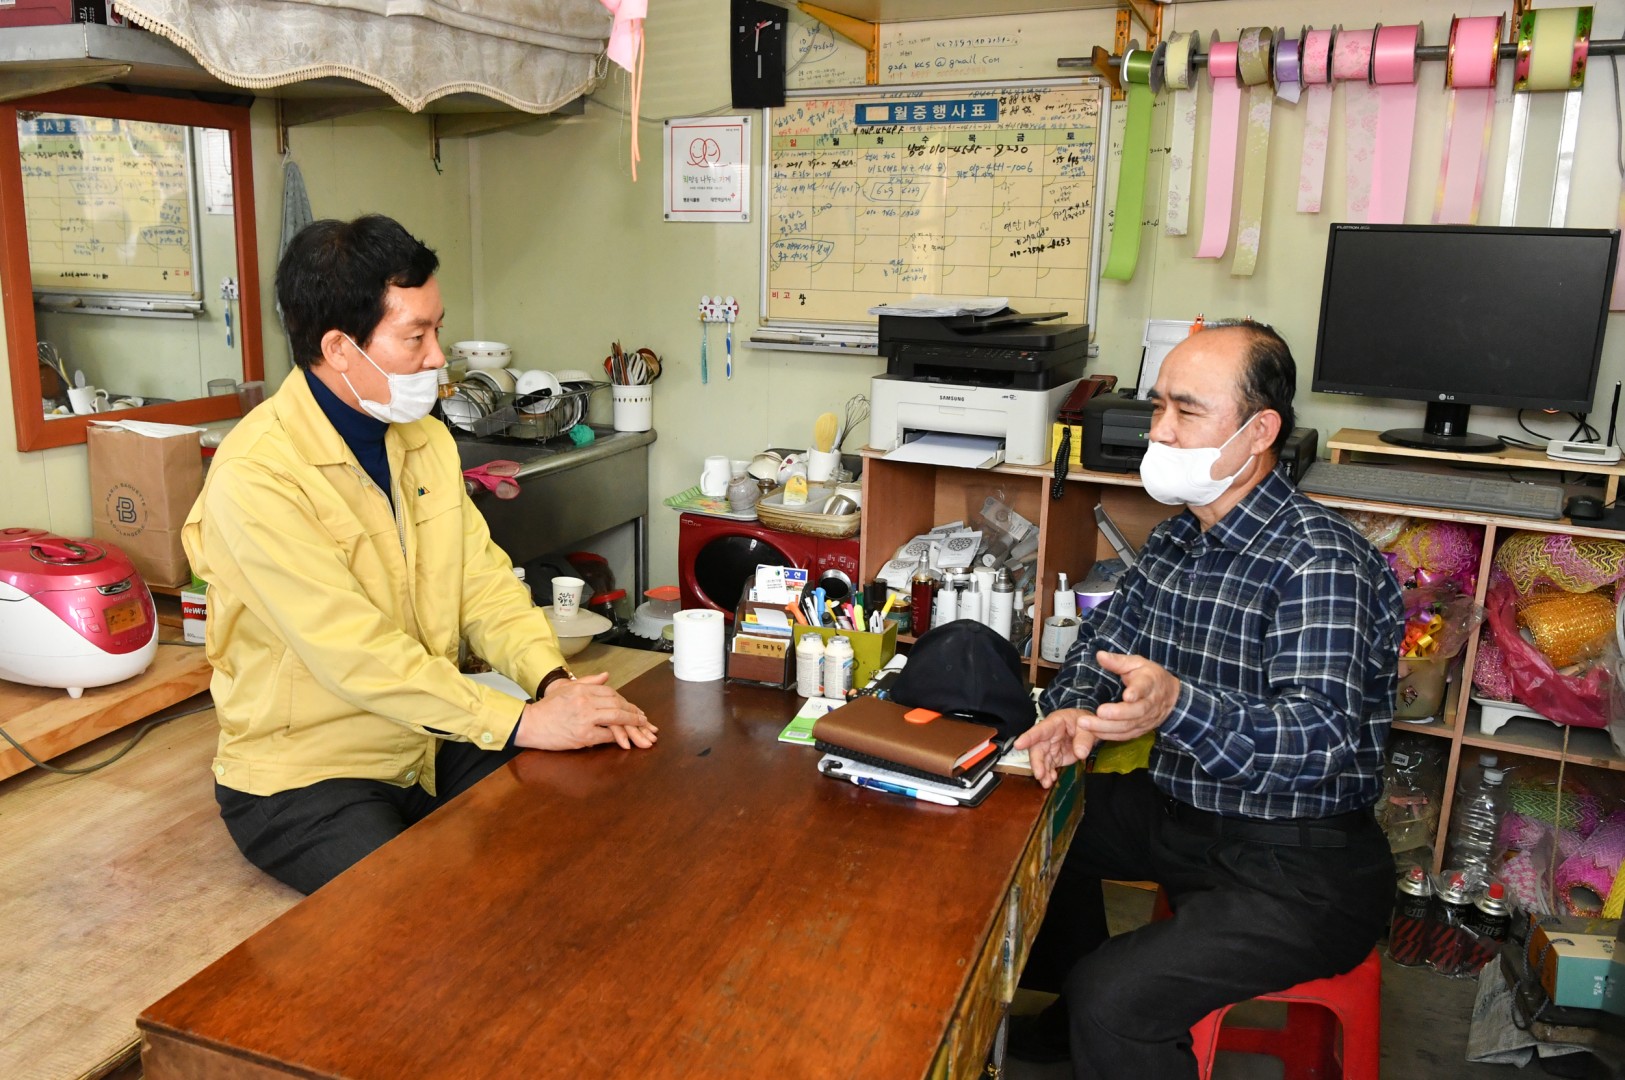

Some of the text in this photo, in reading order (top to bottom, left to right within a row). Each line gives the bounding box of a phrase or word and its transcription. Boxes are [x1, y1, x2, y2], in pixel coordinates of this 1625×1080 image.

[935, 57, 946, 67] @
[949, 54, 976, 68] gmail
[893, 103, 986, 121] 월중행사표
[877, 136, 884, 145] 화
[921, 135, 930, 143] 수
[968, 134, 976, 142] 목
[1017, 133, 1025, 142] 금
[1066, 132, 1075, 140] 토
[790, 138, 797, 147] 일
[833, 137, 839, 146] 월
[700, 174, 716, 184] 나누는
[939, 394, 965, 402] SAMSUNG
